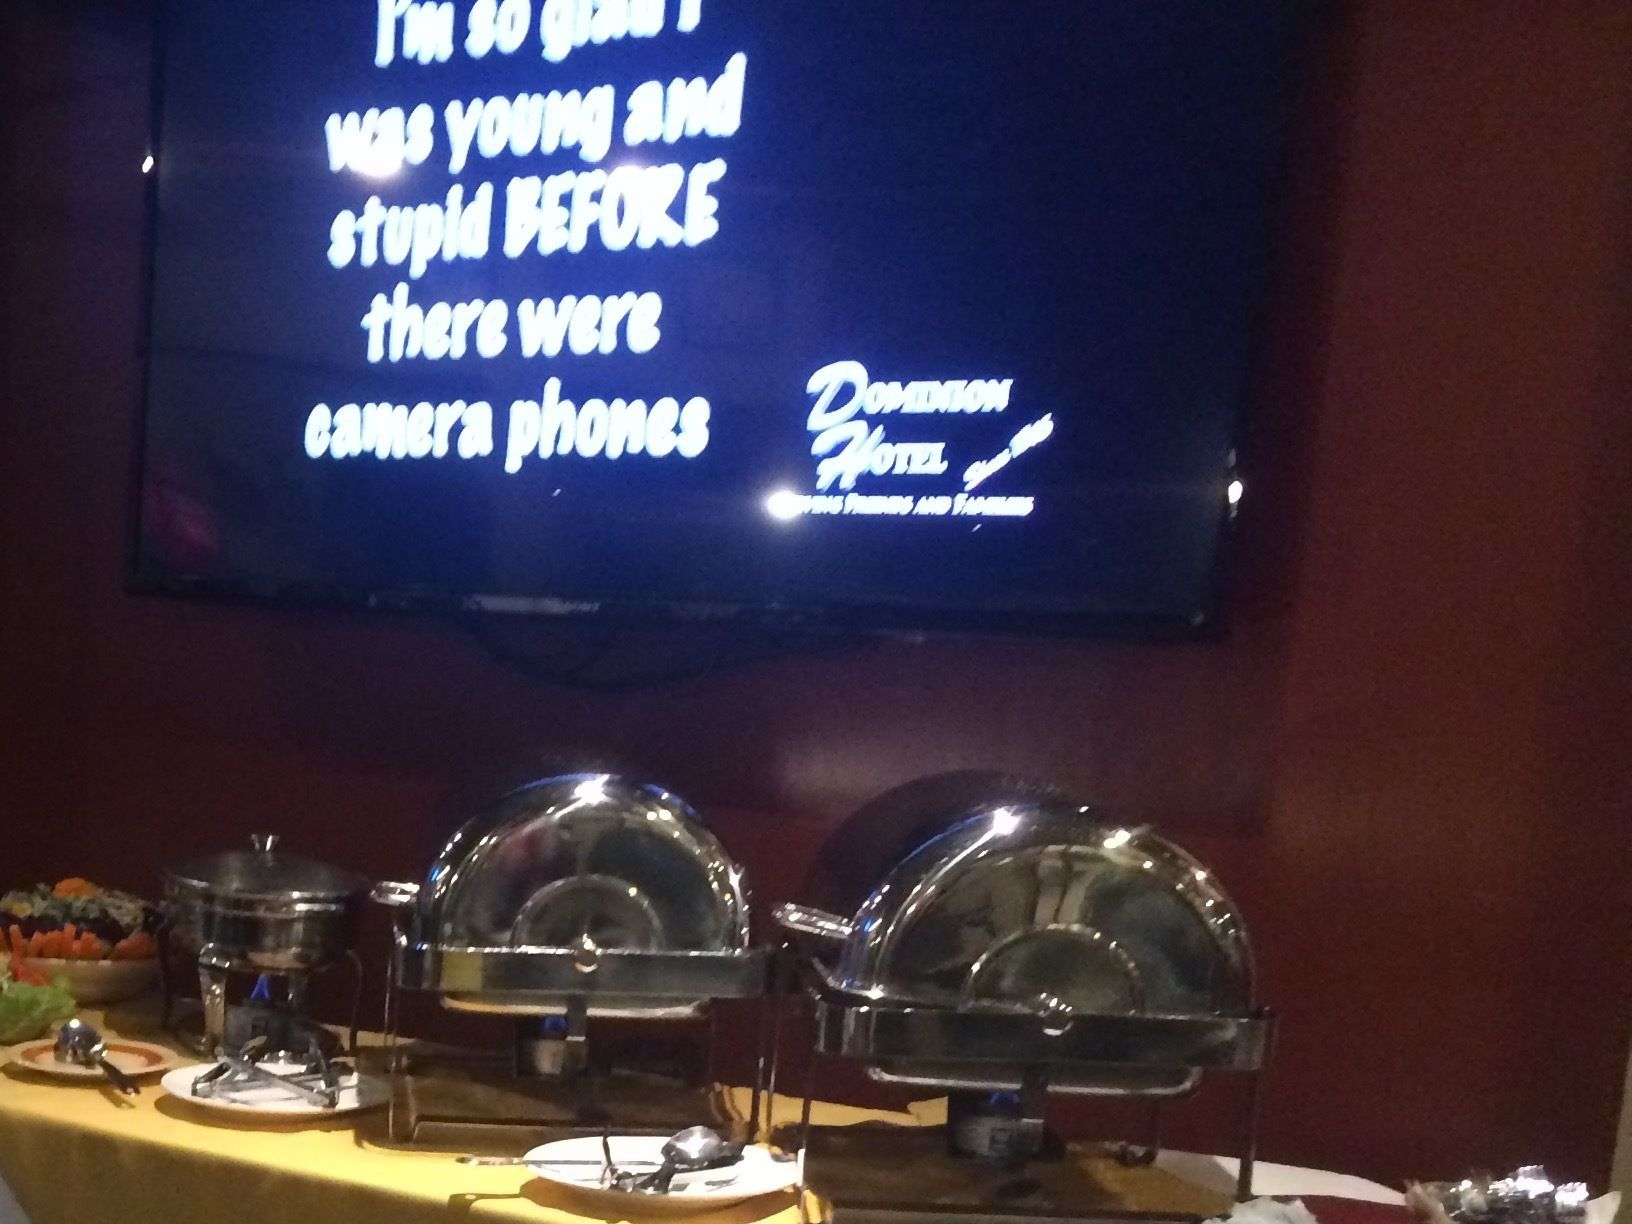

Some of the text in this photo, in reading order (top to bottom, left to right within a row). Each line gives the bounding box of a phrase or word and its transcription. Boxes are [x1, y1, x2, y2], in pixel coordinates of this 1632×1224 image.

[375, 0, 454, 66] I'm
[466, 0, 531, 57] so
[325, 53, 746, 175] was young and
[327, 158, 726, 278] stupid BEFORE
[361, 282, 662, 362] there were
[305, 377, 710, 473] camera phones
